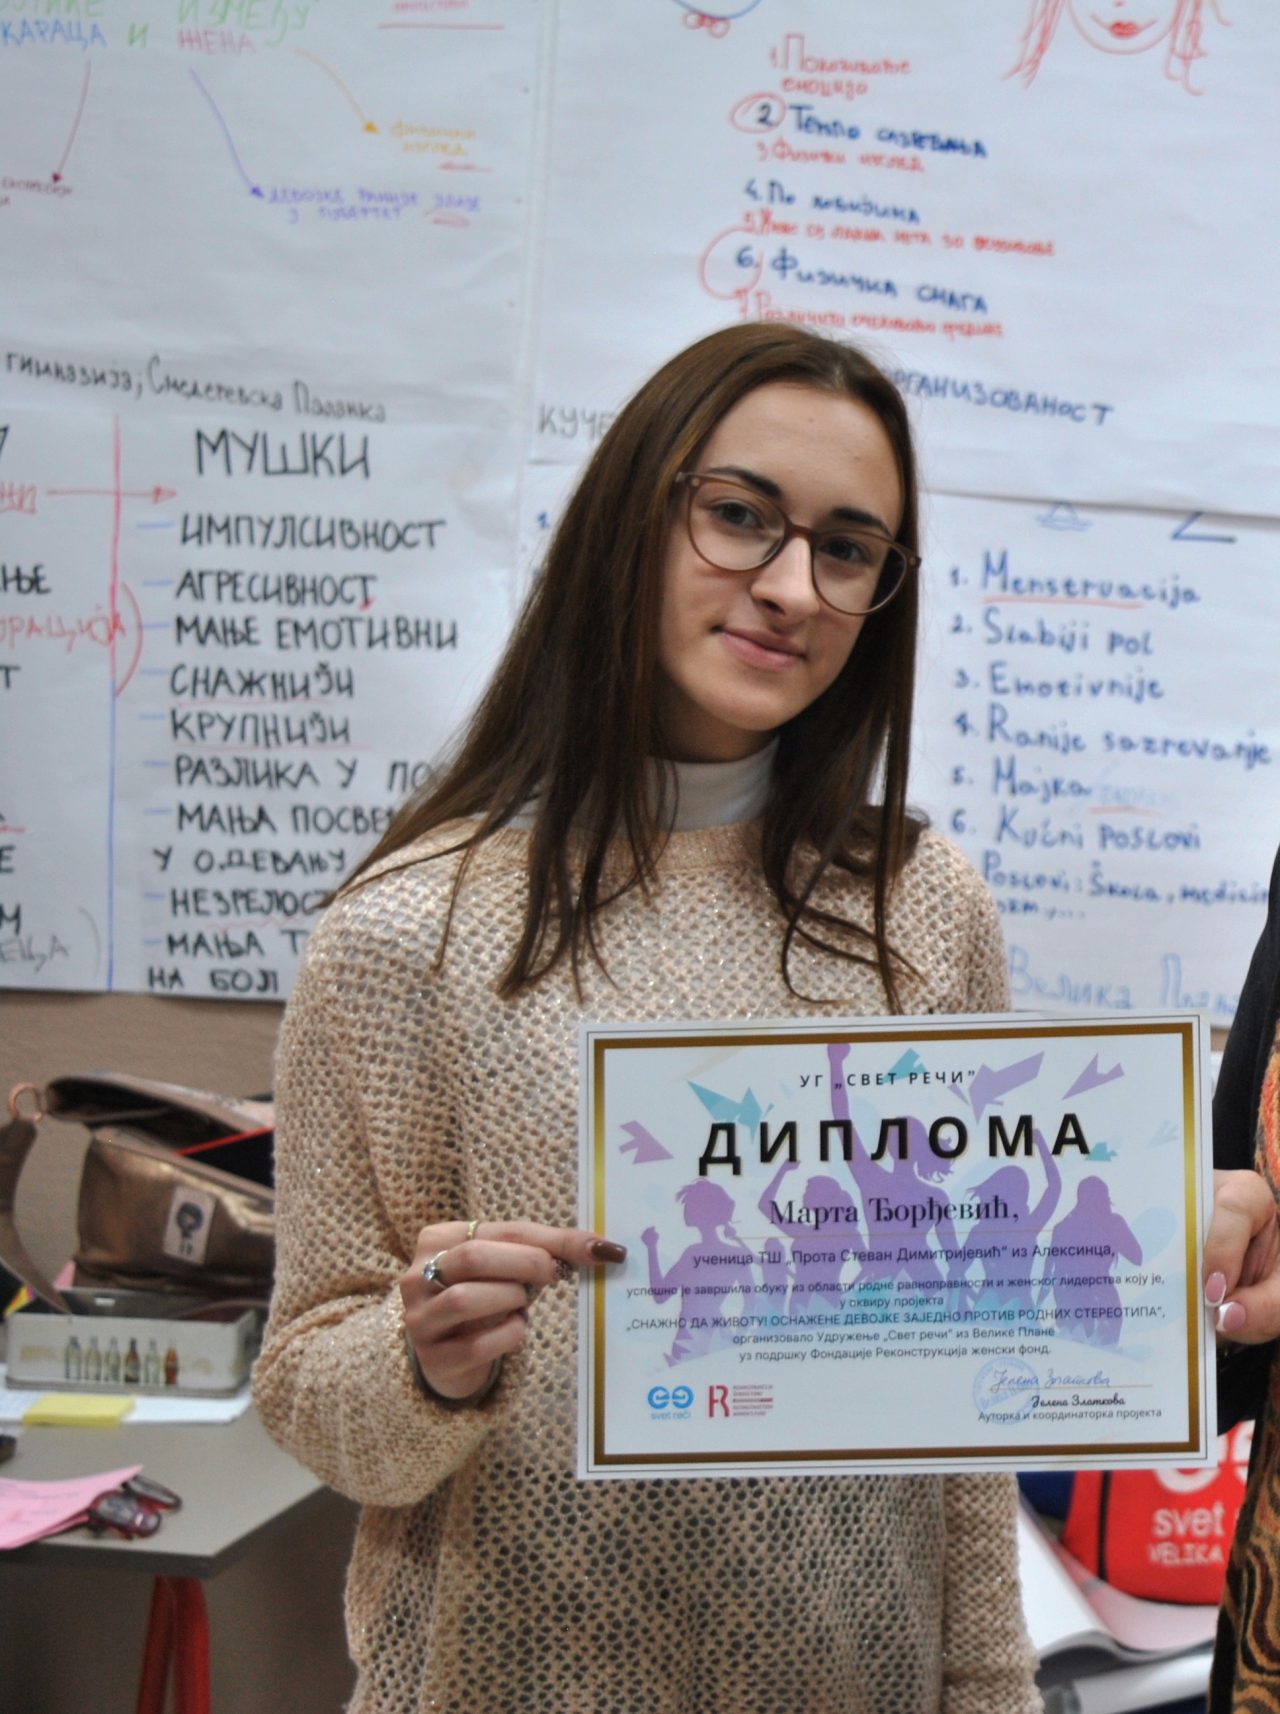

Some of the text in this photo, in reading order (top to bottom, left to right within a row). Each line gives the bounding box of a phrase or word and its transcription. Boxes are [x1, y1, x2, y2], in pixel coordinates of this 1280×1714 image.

[127, 22, 149, 48] И
[177, 28, 256, 54] ЖЕНА
[195, 428, 371, 479] МУШКИ
[180, 513, 447, 551] ИМПУЛСИВНОСТ
[175, 571, 378, 607] АГРЕСИВНОСТ
[981, 549, 1203, 609] Menstruacija
[175, 615, 459, 652] МАЊЕ ЕМОТИВНИ
[988, 660, 1165, 704] Emotivnije
[988, 702, 1086, 756] Ranije
[1102, 728, 1273, 770] sazrevanje
[175, 755, 320, 788] РАЗЛИКА
[336, 759, 358, 789] У
[994, 755, 1093, 804] Majka
[177, 804, 277, 836] МАЊА
[153, 847, 173, 872] У
[167, 927, 265, 960] МАЊА
[148, 965, 184, 990] НА
[800, 1075, 823, 1088] УГ
[698, 1112, 1090, 1177] ДИПЛОМА
[769, 1194, 1020, 1231] Марта Ђорђевић,
[693, 1253, 753, 1269] ученица
[758, 1251, 782, 1264] ТШ
[840, 1249, 892, 1263] Стеван
[1012, 1247, 1028, 1258] из
[1032, 1244, 1115, 1259] Алексинца,
[626, 1286, 677, 1298] успешно
[681, 1284, 691, 1298] је
[694, 1284, 751, 1298] завршила
[754, 1281, 789, 1295] обуку
[792, 1284, 804, 1293] из
[808, 1280, 855, 1293] области
[858, 1281, 893, 1293] родне
[897, 1278, 994, 1292] равноправности
[1007, 1277, 1056, 1288] женског
[1060, 1274, 1122, 1288] лидерства
[1125, 1274, 1149, 1287] коју
[849, 1298, 890, 1310] оквиру
[894, 1295, 944, 1309] пројекта
[690, 1317, 708, 1330] ДА
[771, 1313, 840, 1326] ОСНАЖЕНЕ
[844, 1313, 899, 1326] ДЕВОЈКЕ
[903, 1311, 961, 1324] ЗАЈЕДНО
[964, 1310, 1015, 1322] ПРОТИВ
[1018, 1308, 1071, 1321] РОДНИХ
[732, 1333, 814, 1345] организовало
[817, 1330, 880, 1344] Удружење
[956, 1331, 969, 1340] из
[972, 1327, 1015, 1339] Велике
[1018, 1326, 1055, 1338] Плане
[739, 1350, 752, 1361] уз
[755, 1349, 807, 1361] подршку
[810, 1347, 872, 1361] Фондације
[876, 1345, 968, 1361] Реконструкција
[971, 1346, 1015, 1356] женски
[978, 1411, 1020, 1423] Ауторка
[1033, 1409, 1114, 1422] координаторка
[1116, 1407, 1162, 1420] пројекта
[1072, 1392, 1126, 1407] Златкова
[1152, 1500, 1225, 1539] svet
